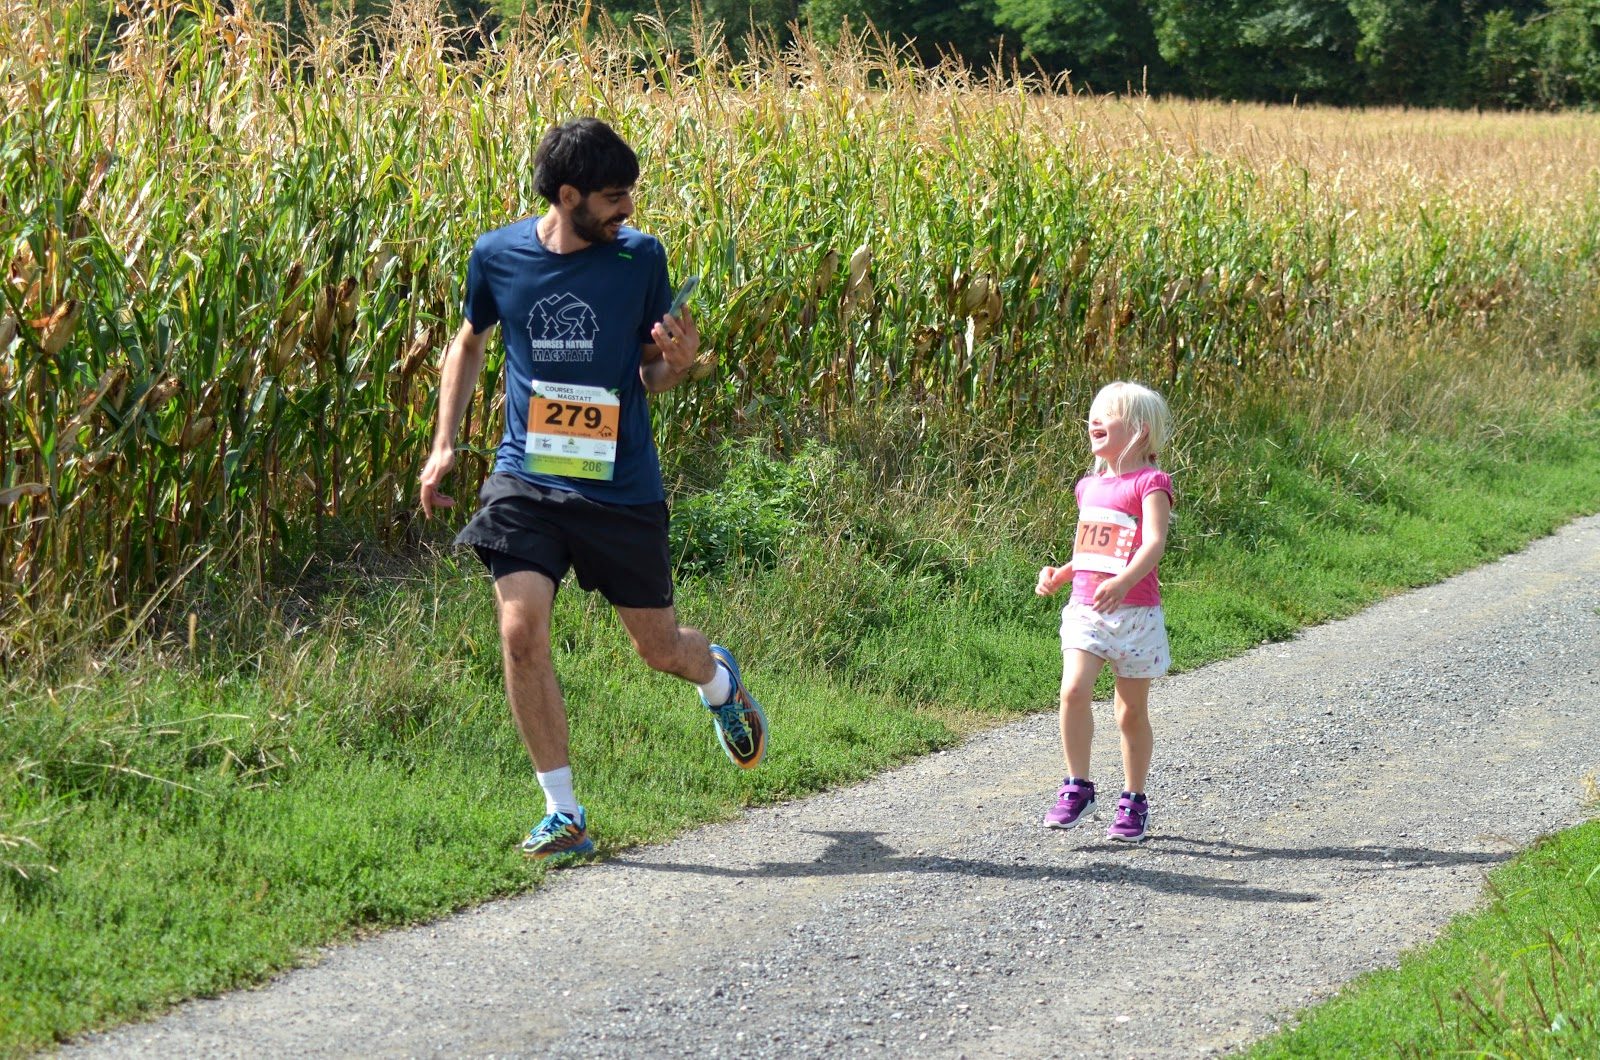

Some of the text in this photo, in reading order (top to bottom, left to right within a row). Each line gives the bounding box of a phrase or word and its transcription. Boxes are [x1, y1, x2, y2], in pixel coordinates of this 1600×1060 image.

[532, 340, 564, 349] COURSES
[533, 350, 593, 361] MAGSTATT
[545, 386, 574, 394] COURSES
[557, 394, 592, 402] MAGSTATT
[545, 402, 602, 429] 279
[1081, 524, 1112, 547] 715
